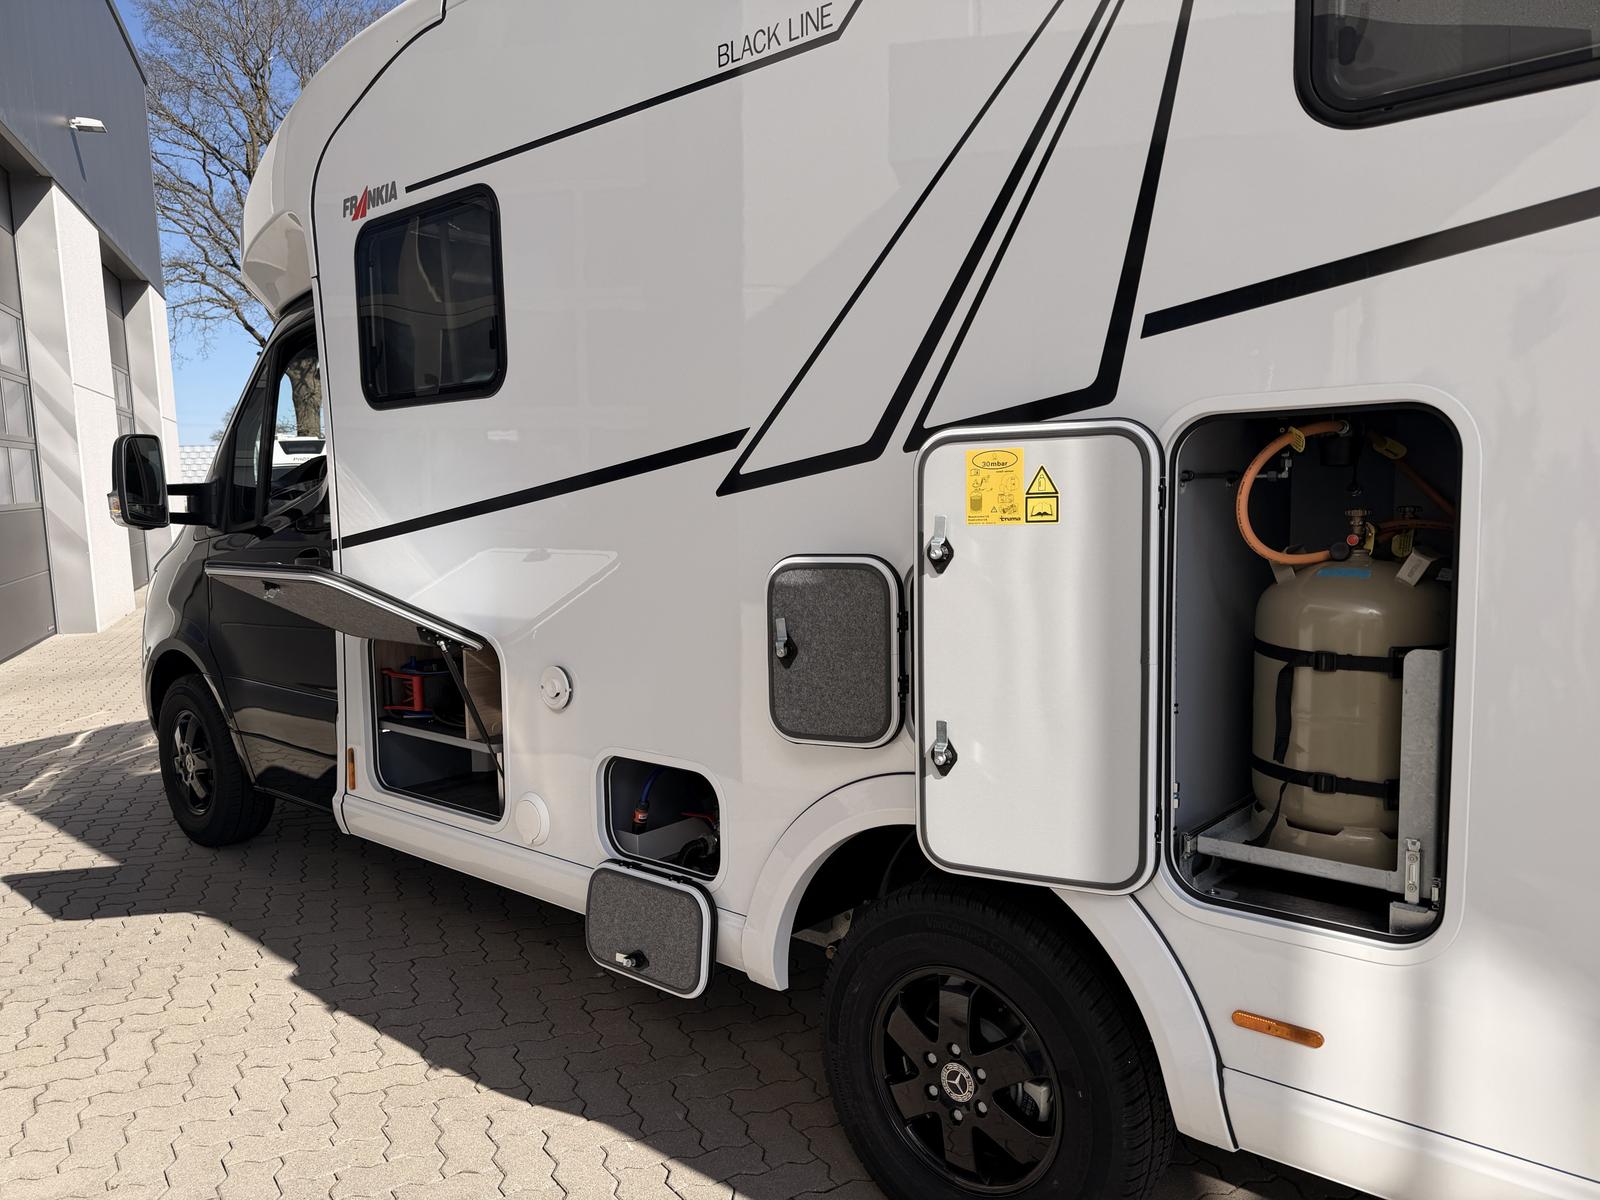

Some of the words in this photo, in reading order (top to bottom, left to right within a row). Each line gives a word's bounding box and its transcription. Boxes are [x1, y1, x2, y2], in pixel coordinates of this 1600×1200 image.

[717, 22, 782, 68] BLACK
[788, 2, 834, 42] LINE
[343, 180, 398, 221] FRANKIA
